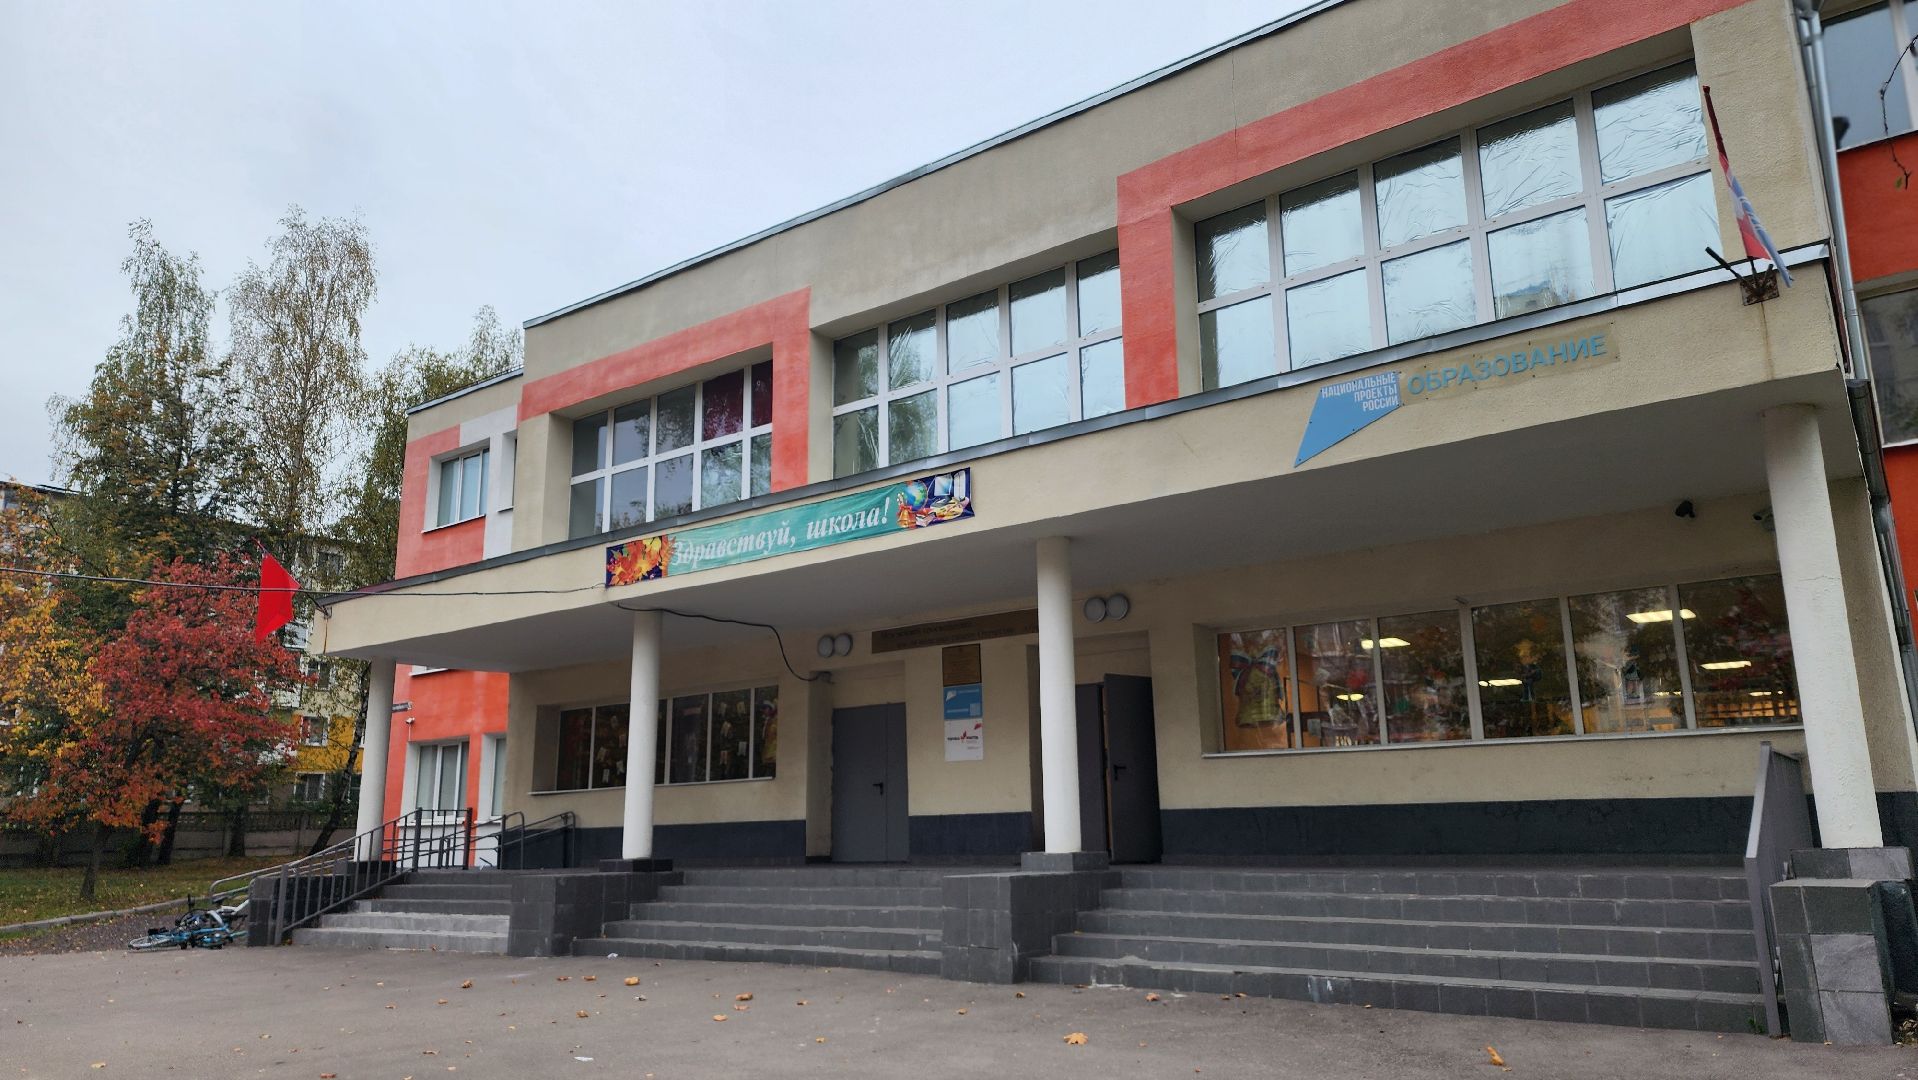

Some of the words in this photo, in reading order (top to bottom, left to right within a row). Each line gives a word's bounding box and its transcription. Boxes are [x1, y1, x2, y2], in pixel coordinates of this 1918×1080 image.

[1407, 335, 1607, 395] ОБРАЗОВАНИЕ
[1321, 372, 1396, 398] НАЦИОНАЛЬНЫЕ
[1354, 384, 1397, 402] ПРОЕКТЫ
[1362, 395, 1398, 412] РОССИИ
[672, 520, 796, 569] Здравствуй,
[806, 497, 890, 541] школа!
